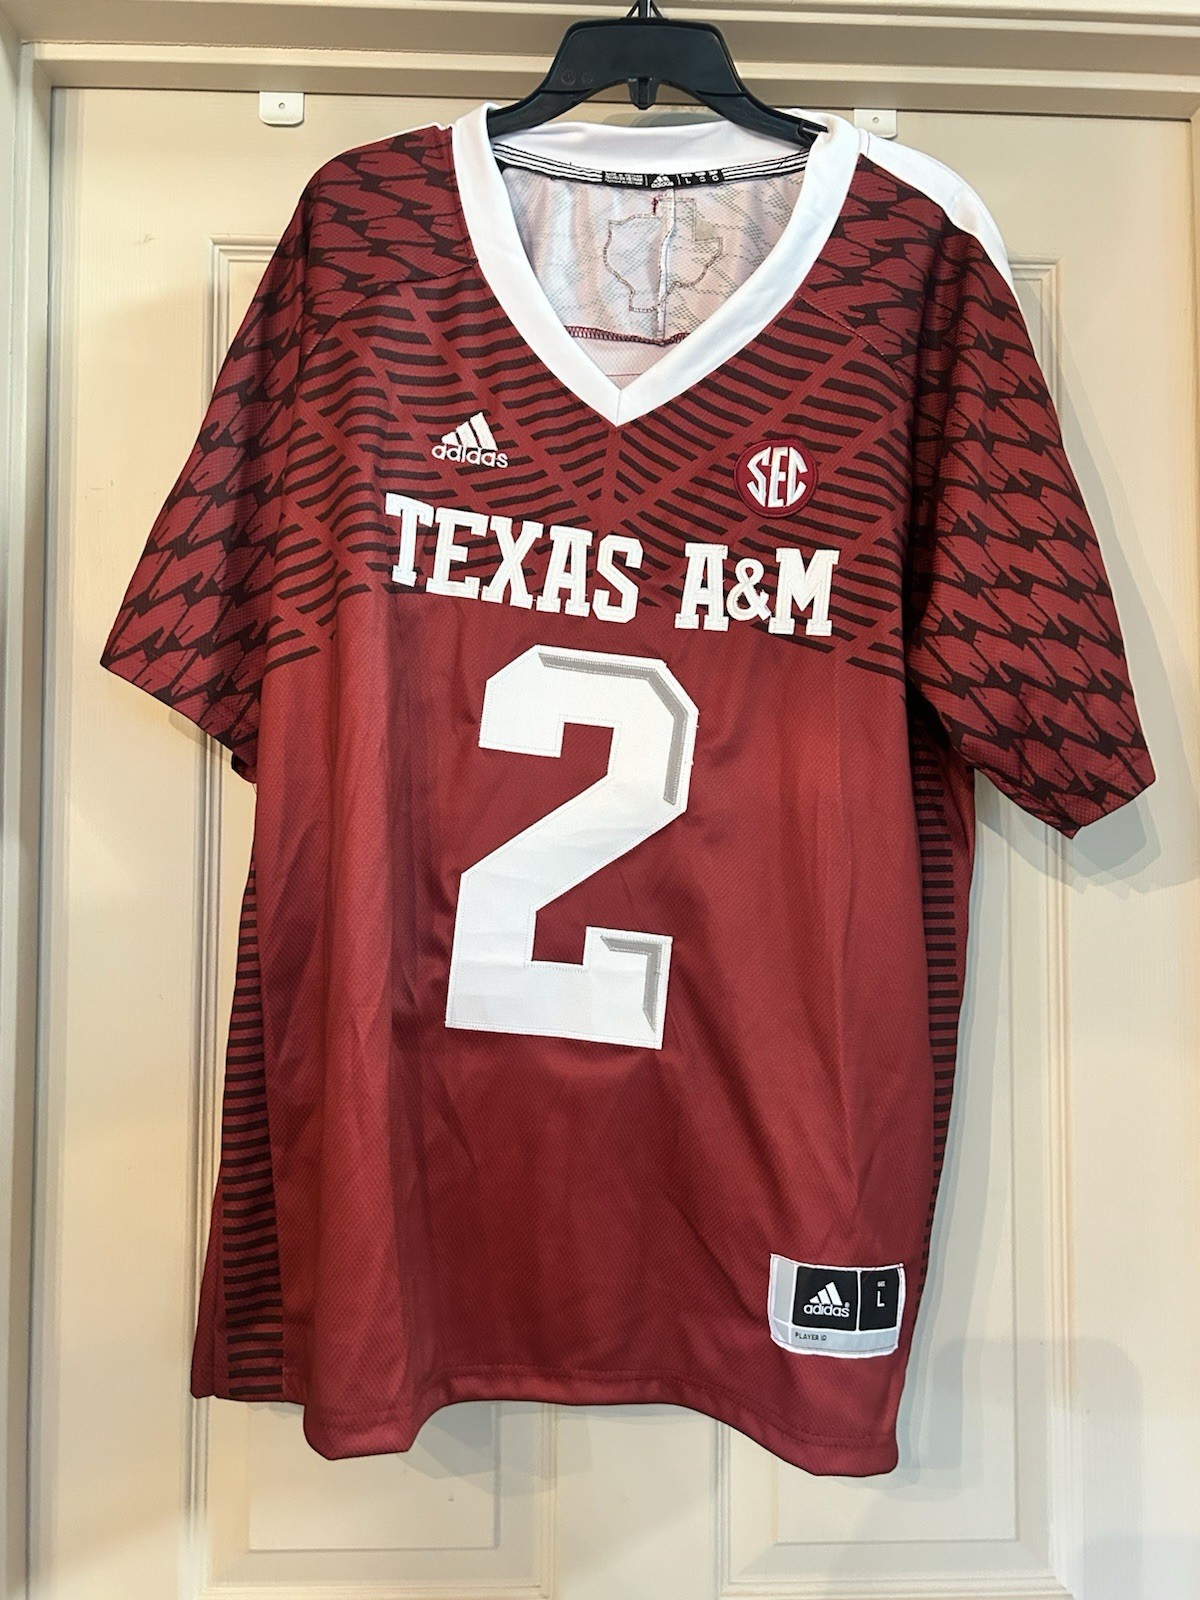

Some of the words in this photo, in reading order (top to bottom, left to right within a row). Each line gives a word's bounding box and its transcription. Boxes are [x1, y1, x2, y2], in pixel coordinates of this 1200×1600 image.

[431, 442, 509, 469] adidas
[745, 446, 807, 508] SEC
[385, 492, 643, 624] TEXAS
[674, 542, 840, 636] A&M
[445, 644, 699, 1050] 2
[803, 1303, 850, 1318] adidas
[877, 1290, 885, 1307] L
[795, 1331, 819, 1341] PLAYER
